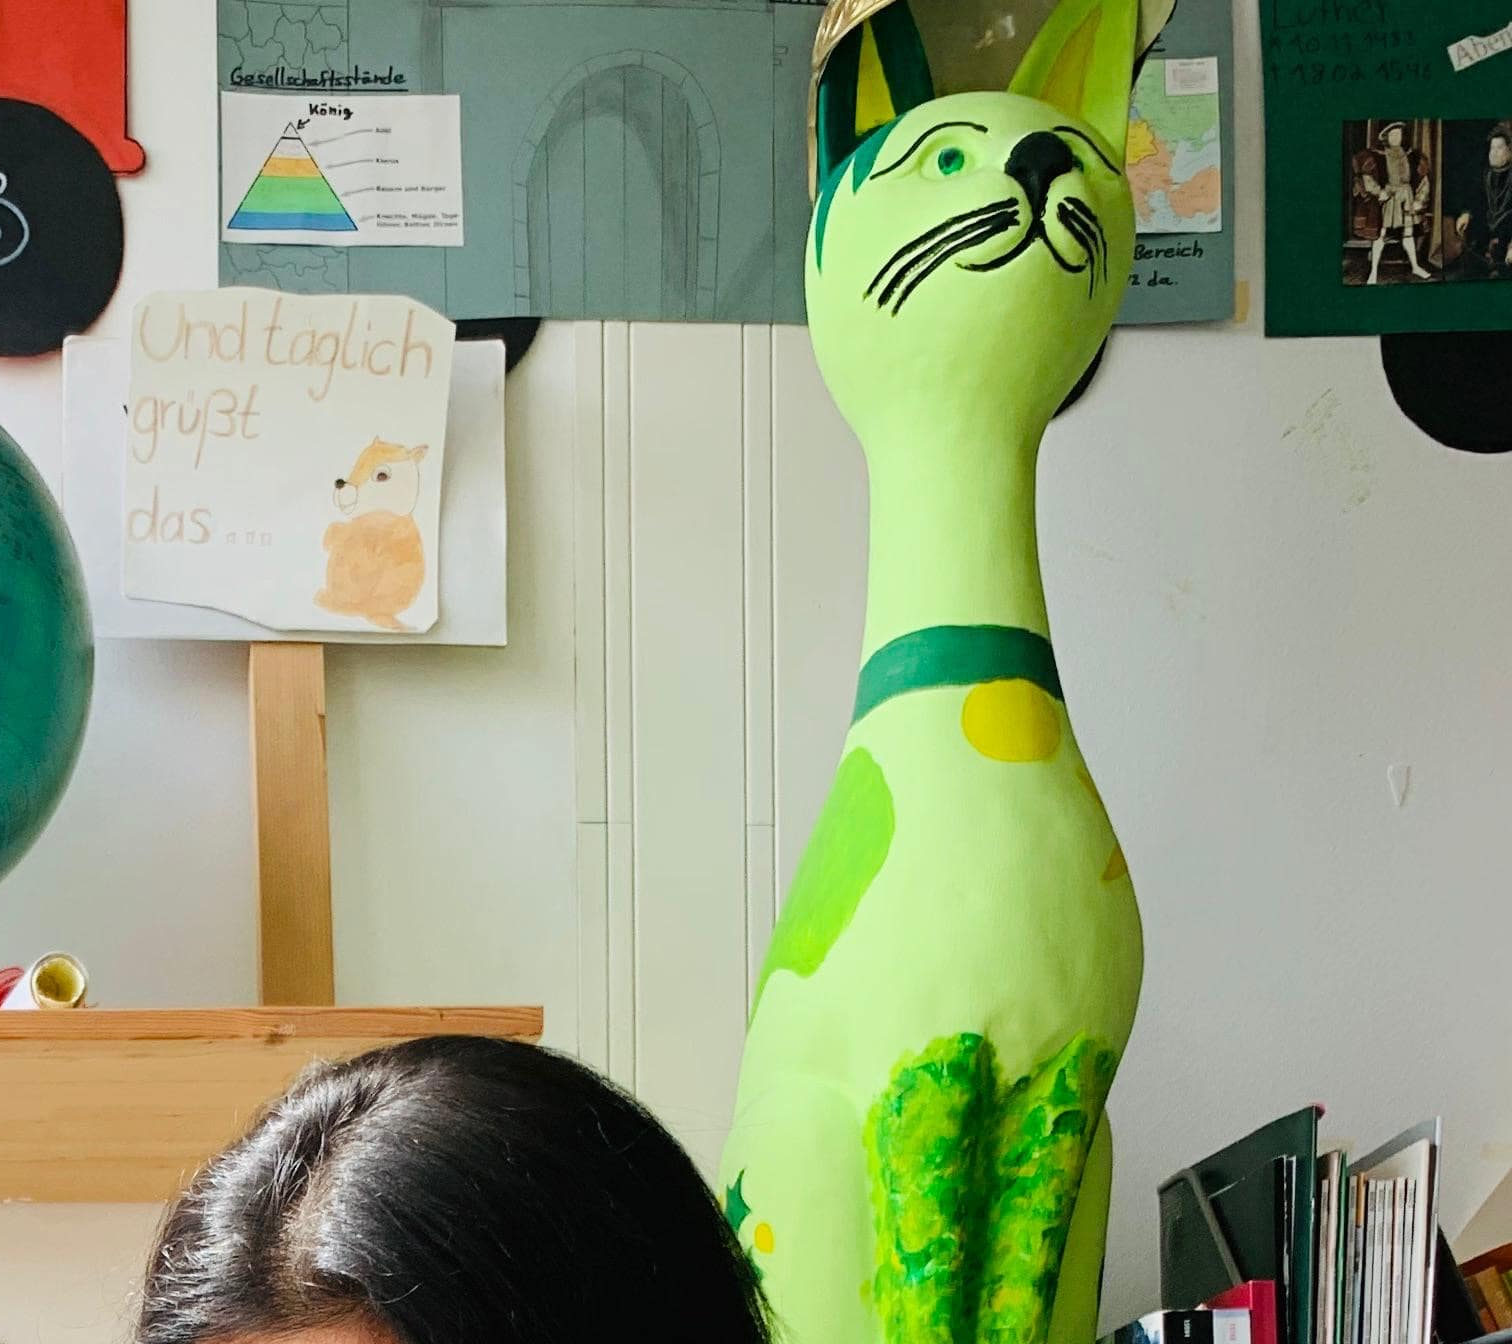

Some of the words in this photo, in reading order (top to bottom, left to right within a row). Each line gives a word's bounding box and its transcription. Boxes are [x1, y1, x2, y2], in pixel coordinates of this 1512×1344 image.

[230, 65, 407, 87] Gesellschaftsstände
[309, 103, 354, 120] König
[138, 299, 249, 366] Und
[264, 296, 434, 402] täglich
[130, 384, 262, 470] grüßt
